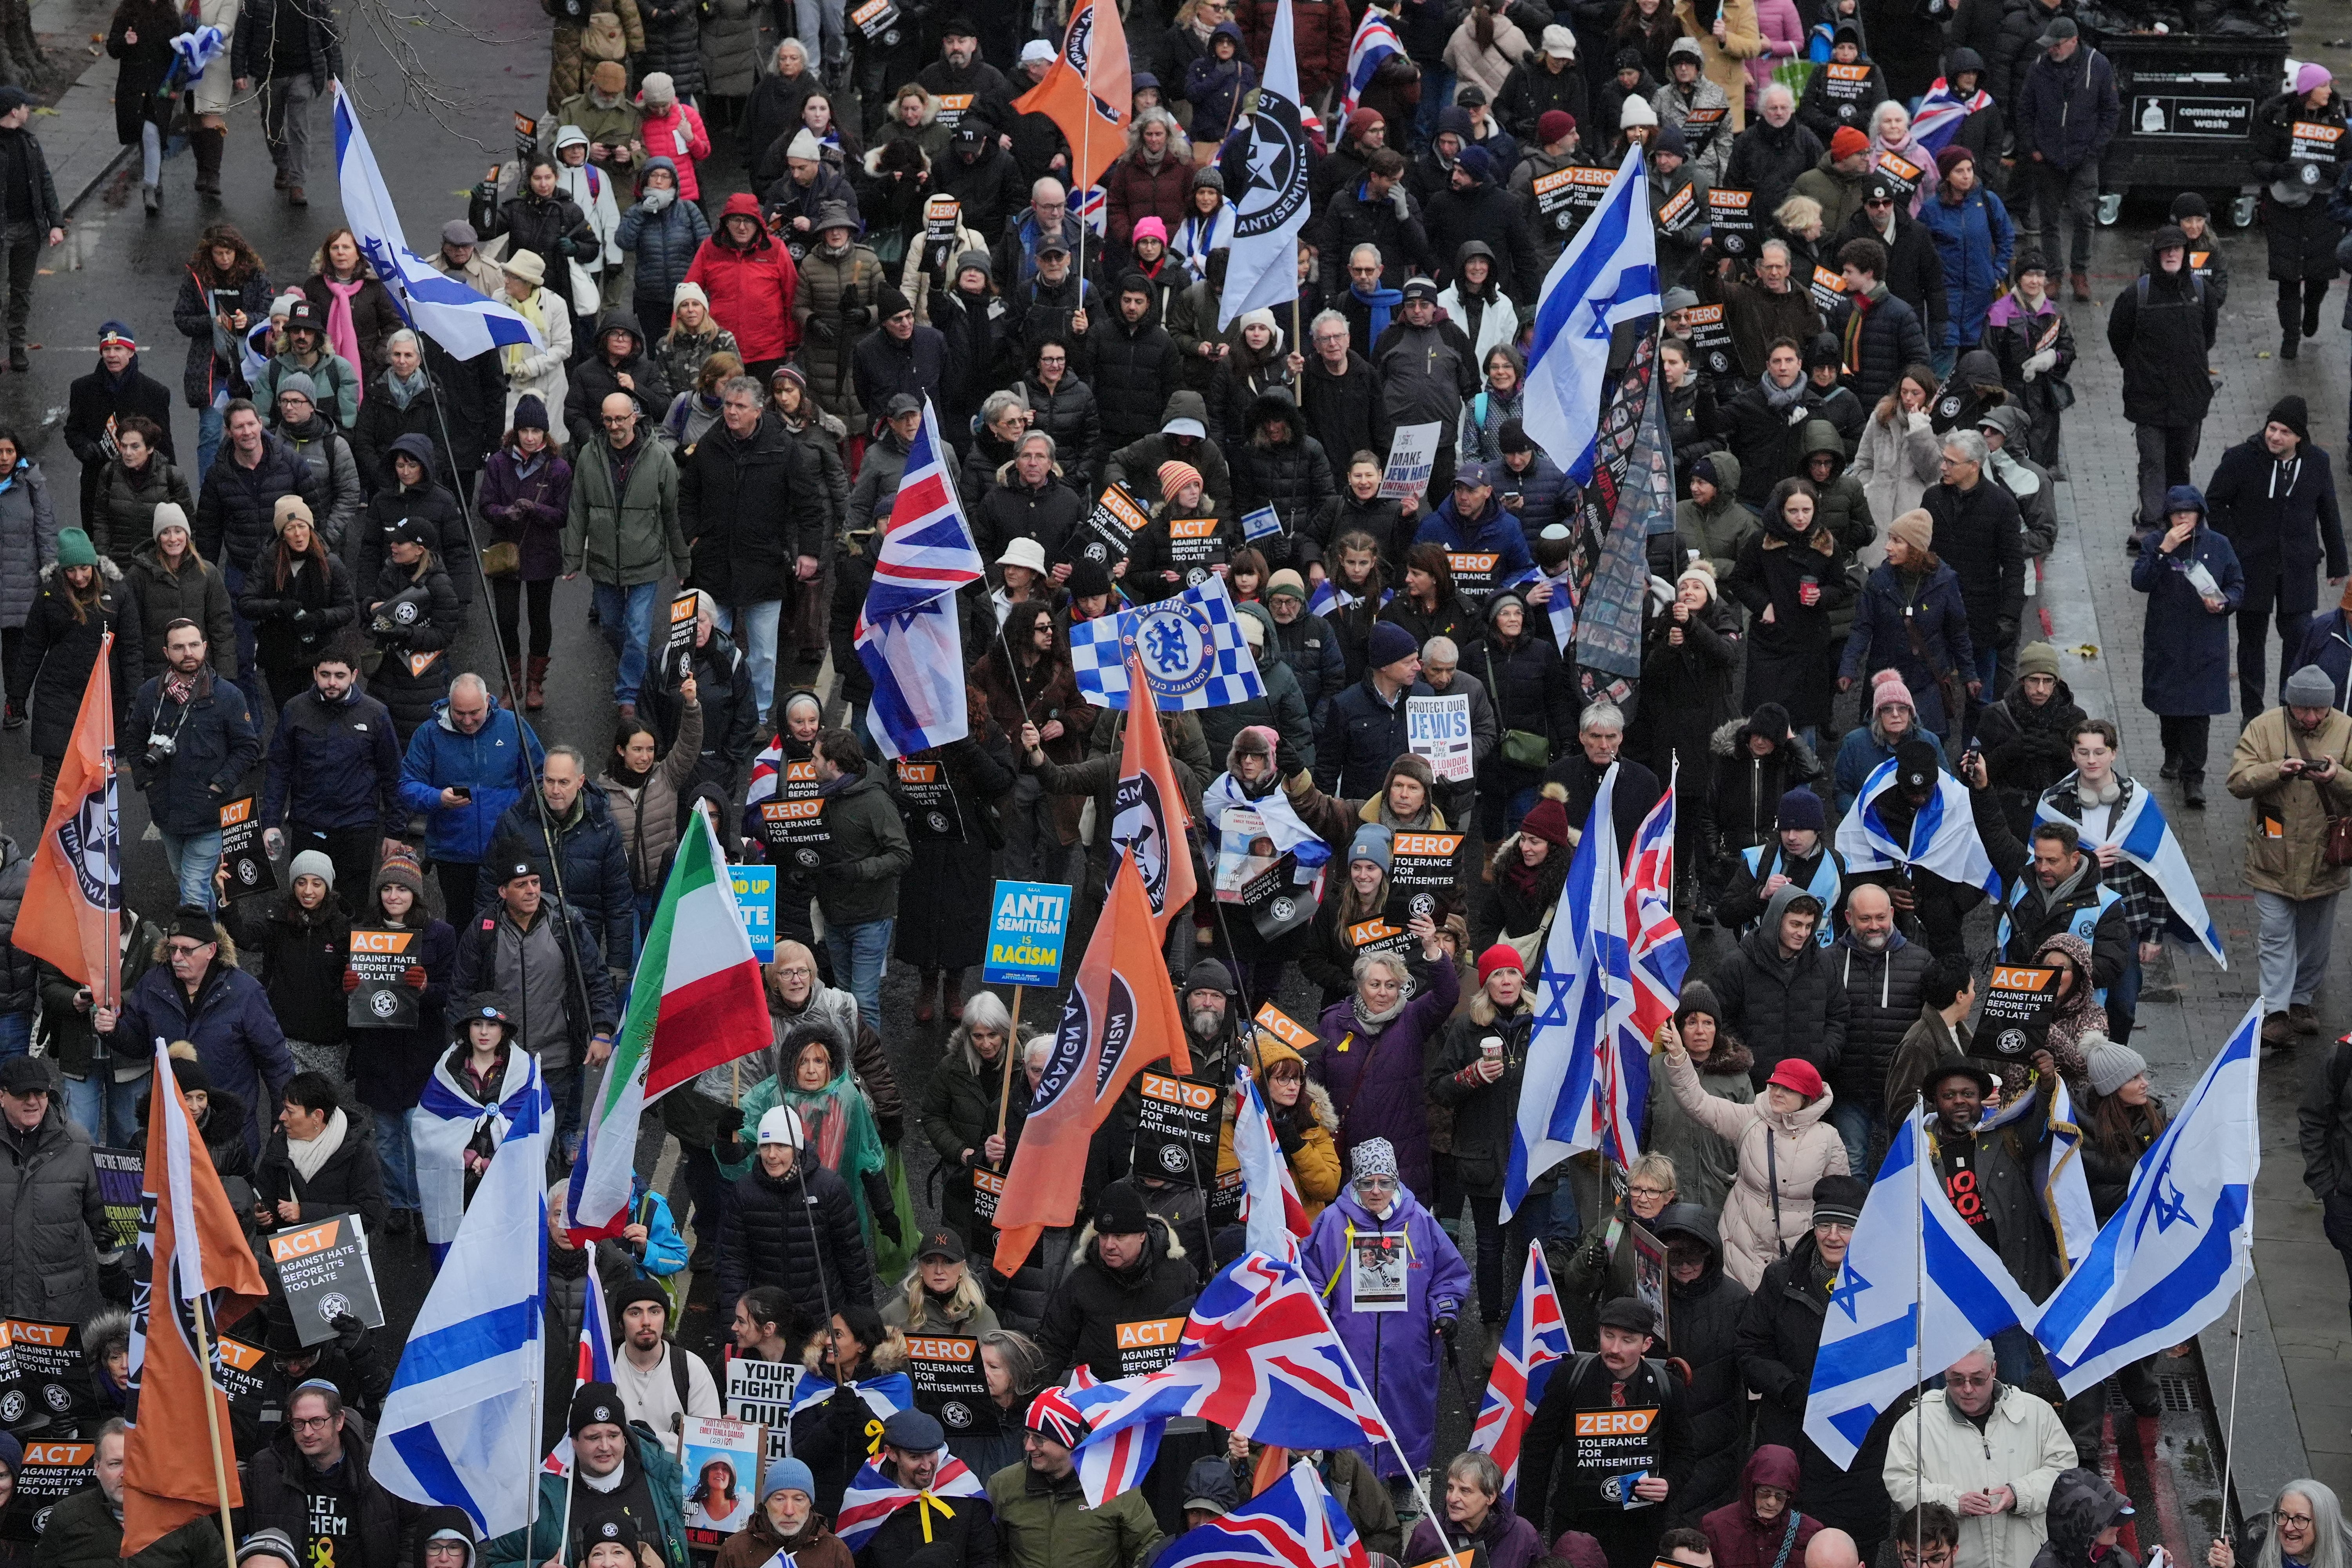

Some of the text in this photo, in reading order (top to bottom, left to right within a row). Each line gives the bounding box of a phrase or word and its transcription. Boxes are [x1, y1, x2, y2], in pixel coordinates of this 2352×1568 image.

[1829, 65, 1860, 78] ACT
[1687, 111, 1715, 120] ACT
[2180, 106, 2245, 118] commercial
[2194, 119, 2229, 129] waste
[2295, 123, 2337, 139] ZERO
[1881, 154, 1910, 175] ACT
[1536, 170, 1572, 192] ZERO
[1574, 169, 1615, 183] ZERO
[1877, 165, 1916, 191] AGAINST HATE
[1662, 189, 1691, 220] ZERO
[1710, 191, 1747, 205] ZERO
[931, 204, 956, 219] ZERO
[1710, 207, 1748, 216] TOLERANCE
[1816, 269, 1840, 289] ACT
[1689, 307, 1721, 323] ZERO
[1692, 323, 1724, 333] TOLERANCE
[1696, 337, 1731, 348] ANTISEMITES
[1391, 451, 1422, 466] MAKE
[1386, 464, 1432, 481] JEW HATE
[1103, 491, 1140, 528] ZERO
[1092, 511, 1107, 526] FOR
[1097, 505, 1134, 539] TOLERANCE
[1087, 518, 1129, 554] ANTISEMITES
[1172, 521, 1205, 536] ACT
[672, 600, 691, 621] ACT
[671, 620, 688, 632] AGAINST
[671, 629, 687, 640] BEFORE
[1408, 700, 1466, 713] PROTECT OUR
[1410, 711, 1466, 739] JEWS
[1437, 756, 1466, 769] LONDON
[900, 767, 926, 780] ACT
[1450, 764, 1468, 777] JEWS
[222, 804, 243, 825] ACT
[764, 802, 819, 820] ZERO
[222, 820, 258, 837] AGAINST HATE
[767, 818, 822, 829] TOLERANCE
[223, 834, 241, 846] BEFORE
[773, 833, 830, 843] ANTISEMITES
[1396, 836, 1454, 853] ZERO
[234, 841, 248, 851] LATE
[1395, 857, 1452, 867] TOLERANCE
[1391, 876, 1454, 885] ANTISEMITES
[1244, 878, 1271, 900] BEFORE
[1246, 882, 1281, 906] TOO LATE
[998, 893, 1064, 920] ANTI
[996, 917, 1060, 934] SEMITISM
[353, 934, 397, 950] ACT
[1022, 935, 1031, 944] IS
[1359, 936, 1394, 955] AGAINST
[352, 955, 392, 963] AGAINST
[992, 944, 1056, 966] RACISM
[390, 964, 405, 972] IT'S
[373, 973, 396, 981] LATE
[1993, 969, 2039, 988] ACT
[372, 992, 396, 1002] CAMPAIGN AGAINST
[1989, 991, 2054, 1002] AGAINST HATE
[1987, 999, 2040, 1011] BEFORE IT'S
[1985, 1008, 2030, 1020] TOO LATE
[1258, 1009, 1303, 1042] ACT
[1145, 1076, 1210, 1106] ZERO
[1141, 1109, 1163, 1122] FOR
[1142, 1099, 1209, 1122] TOLERANCE
[1161, 1145, 1187, 1160] CAMPAIGN AGAINST
[93, 1152, 143, 1171] WE'RE THOSE
[1163, 1162, 1184, 1171] ANTISEMITISM
[975, 1198, 995, 1212] FOR
[277, 1229, 322, 1259] ACT
[281, 1245, 355, 1274] AGAINST HATE
[283, 1259, 345, 1284] BEFORE IT'S
[285, 1272, 338, 1293] TOO LATE
[320, 1294, 347, 1310] CAMPAIGN AGAINST
[12, 1323, 53, 1343] ACT
[1120, 1322, 1168, 1345] ACT
[15, 1344, 53, 1356] AGAINST
[909, 1340, 970, 1359] ZERO
[1122, 1348, 1166, 1361] AGAINST
[16, 1352, 51, 1365] BEFORE
[53, 1358, 70, 1367] IT'S
[1122, 1359, 1162, 1372] BEFORE
[17, 1361, 62, 1375] TOO LATE
[744, 1363, 795, 1383] YOUR
[912, 1362, 975, 1373] TOLERANCE
[236, 1372, 264, 1389] HATE
[914, 1372, 935, 1381] FOR
[229, 1383, 247, 1394] IT'S
[731, 1379, 786, 1399] FIGHT
[917, 1382, 984, 1393] ANTISEMITES
[1579, 1413, 1648, 1433] ZERO
[713, 1428, 727, 1437] TEHILA
[728, 1430, 745, 1439] DAMARI
[1578, 1437, 1648, 1448] TOLERANCE
[25, 1446, 81, 1463] ACT
[1578, 1449, 1602, 1457] FOR
[1577, 1456, 1653, 1467] ANTISEMITES
[21, 1468, 70, 1476] AGAINST
[19, 1477, 62, 1486] BEFORE
[42, 1487, 70, 1495] LATE
